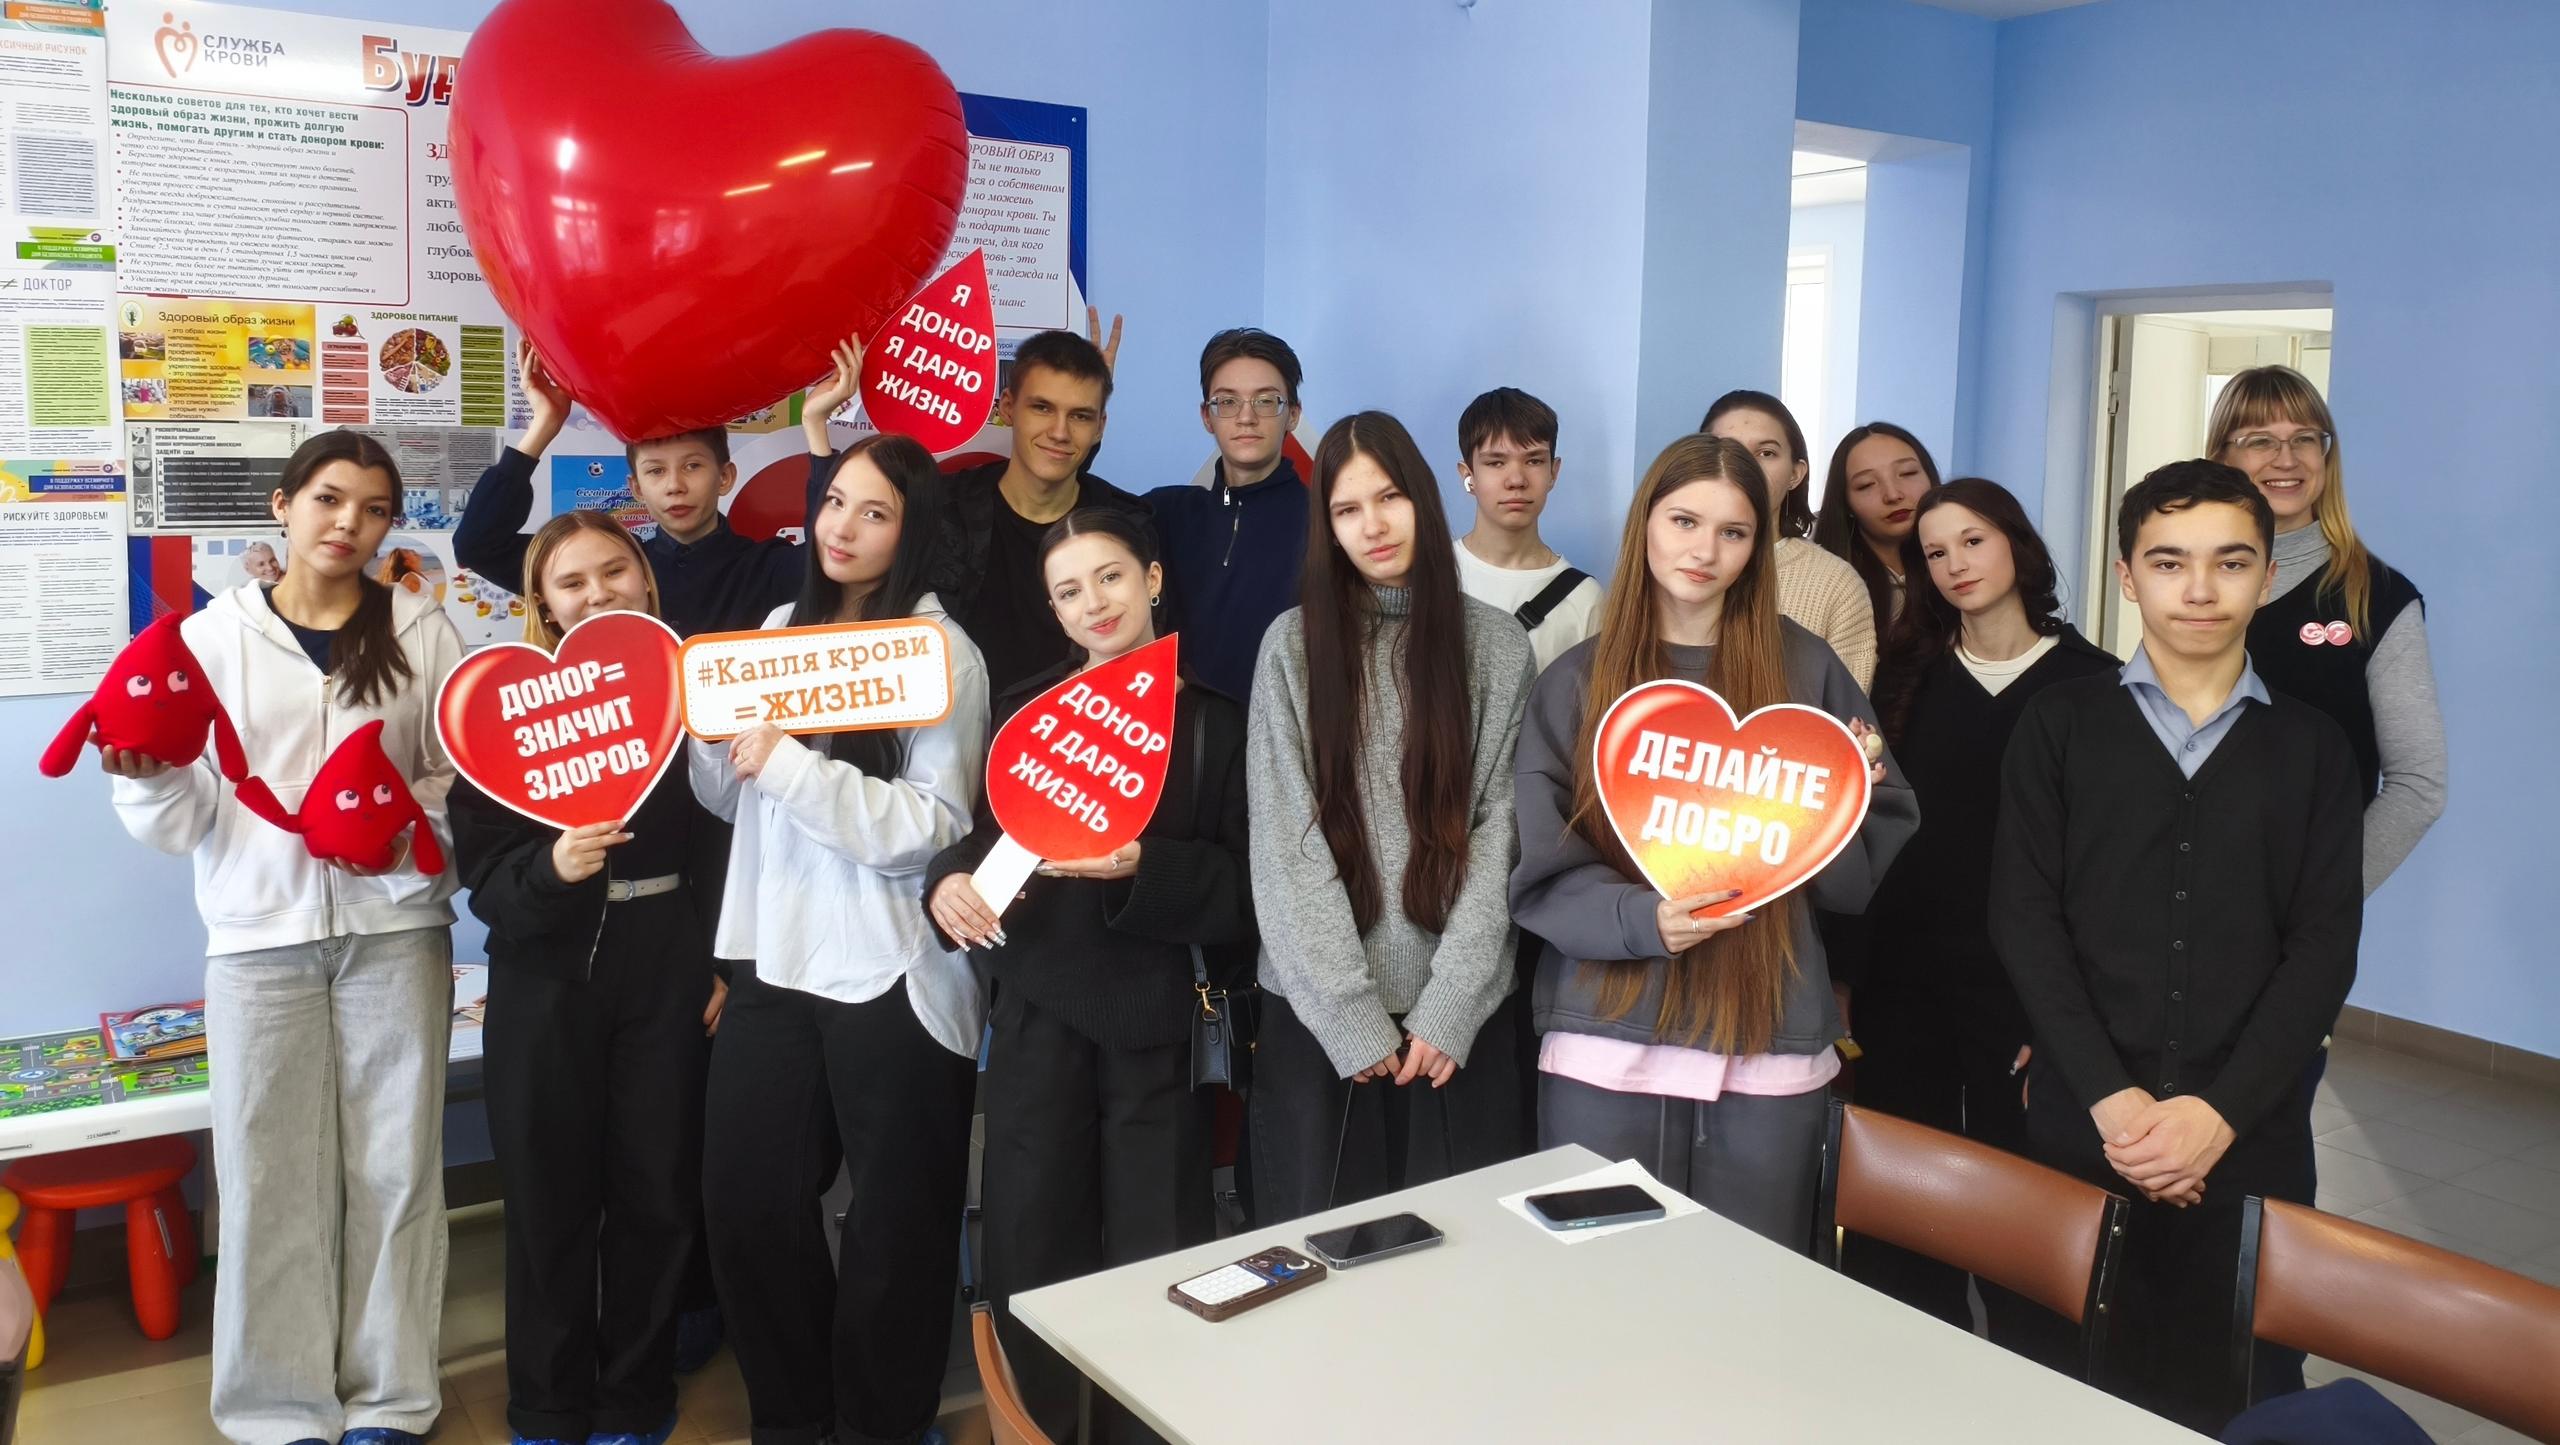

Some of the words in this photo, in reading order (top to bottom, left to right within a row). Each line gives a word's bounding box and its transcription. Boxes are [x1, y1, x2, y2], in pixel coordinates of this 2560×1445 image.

[204, 34, 285, 55] СЛУЖБА
[205, 50, 268, 67] КРОВИ
[110, 88, 172, 103] Несколько
[177, 97, 220, 107] советов
[225, 101, 245, 111] для
[250, 103, 269, 114] тех,
[274, 106, 292, 114] кто
[296, 108, 324, 117] хочет
[329, 111, 358, 120] вести
[111, 105, 168, 117] здоровый
[173, 109, 205, 121] образ
[210, 114, 248, 126] жизни,
[254, 117, 300, 128] прожить
[304, 122, 344, 134] долгую
[112, 119, 151, 131] жизнь,
[157, 123, 209, 134] помогать
[214, 128, 253, 138] другим
[268, 132, 296, 141] стать
[301, 135, 346, 146] донором
[350, 139, 384, 149] крови:
[1019, 150, 1054, 162] ОБРАЗ
[972, 159, 986, 170] Ты
[1004, 166, 1041, 176] только
[426, 174, 452, 187] тру
[998, 179, 1065, 193] собственном
[973, 192, 986, 200] но
[988, 194, 1034, 205] можешь
[1007, 212, 1038, 222] крови.
[1043, 211, 1056, 221] Ты
[969, 221, 1020, 233] подарить
[1024, 228, 1050, 236] шанс
[973, 238, 998, 247] тем,
[1002, 238, 1018, 247] для
[1022, 242, 1044, 250] кого
[984, 253, 1006, 262] ровь
[1016, 255, 1036, 264] это
[24, 278, 72, 290] ДОКТОР
[427, 270, 486, 283] здоровь
[996, 267, 1043, 280] надежда
[1046, 272, 1058, 280] на
[951, 285, 972, 307] Я
[999, 299, 1026, 308] шанс
[159, 311, 219, 324] Здоровый
[223, 314, 256, 325] образ
[371, 312, 418, 320] ЗДОРОВОЕ
[420, 314, 458, 322] ПИТАНИЕ
[900, 304, 992, 355] ДОНОР
[884, 336, 904, 358] Я
[904, 345, 982, 394] ДАРЮ
[875, 371, 962, 426] ЖИЗНЬ
[4, 511, 50, 521] РИСКУЙТЕ
[53, 512, 108, 521] ЗДОРОВЬЕМ!
[698, 646, 820, 687] #Капля
[828, 635, 931, 673] крови
[498, 661, 626, 721] ДОНОР=
[1126, 672, 1155, 699] Я
[514, 696, 634, 758] ЗНАЧИТ
[1058, 681, 1167, 756] ДОНОР
[1030, 714, 1059, 741] Я
[1050, 729, 1144, 798] ДАРЮ
[524, 737, 651, 801] ЗДОРОВ
[1628, 730, 1830, 810] ДЕЛАЙТЕ
[1008, 752, 1110, 834] ЖИЗНЬ
[1641, 794, 1790, 866] ДОБРО
